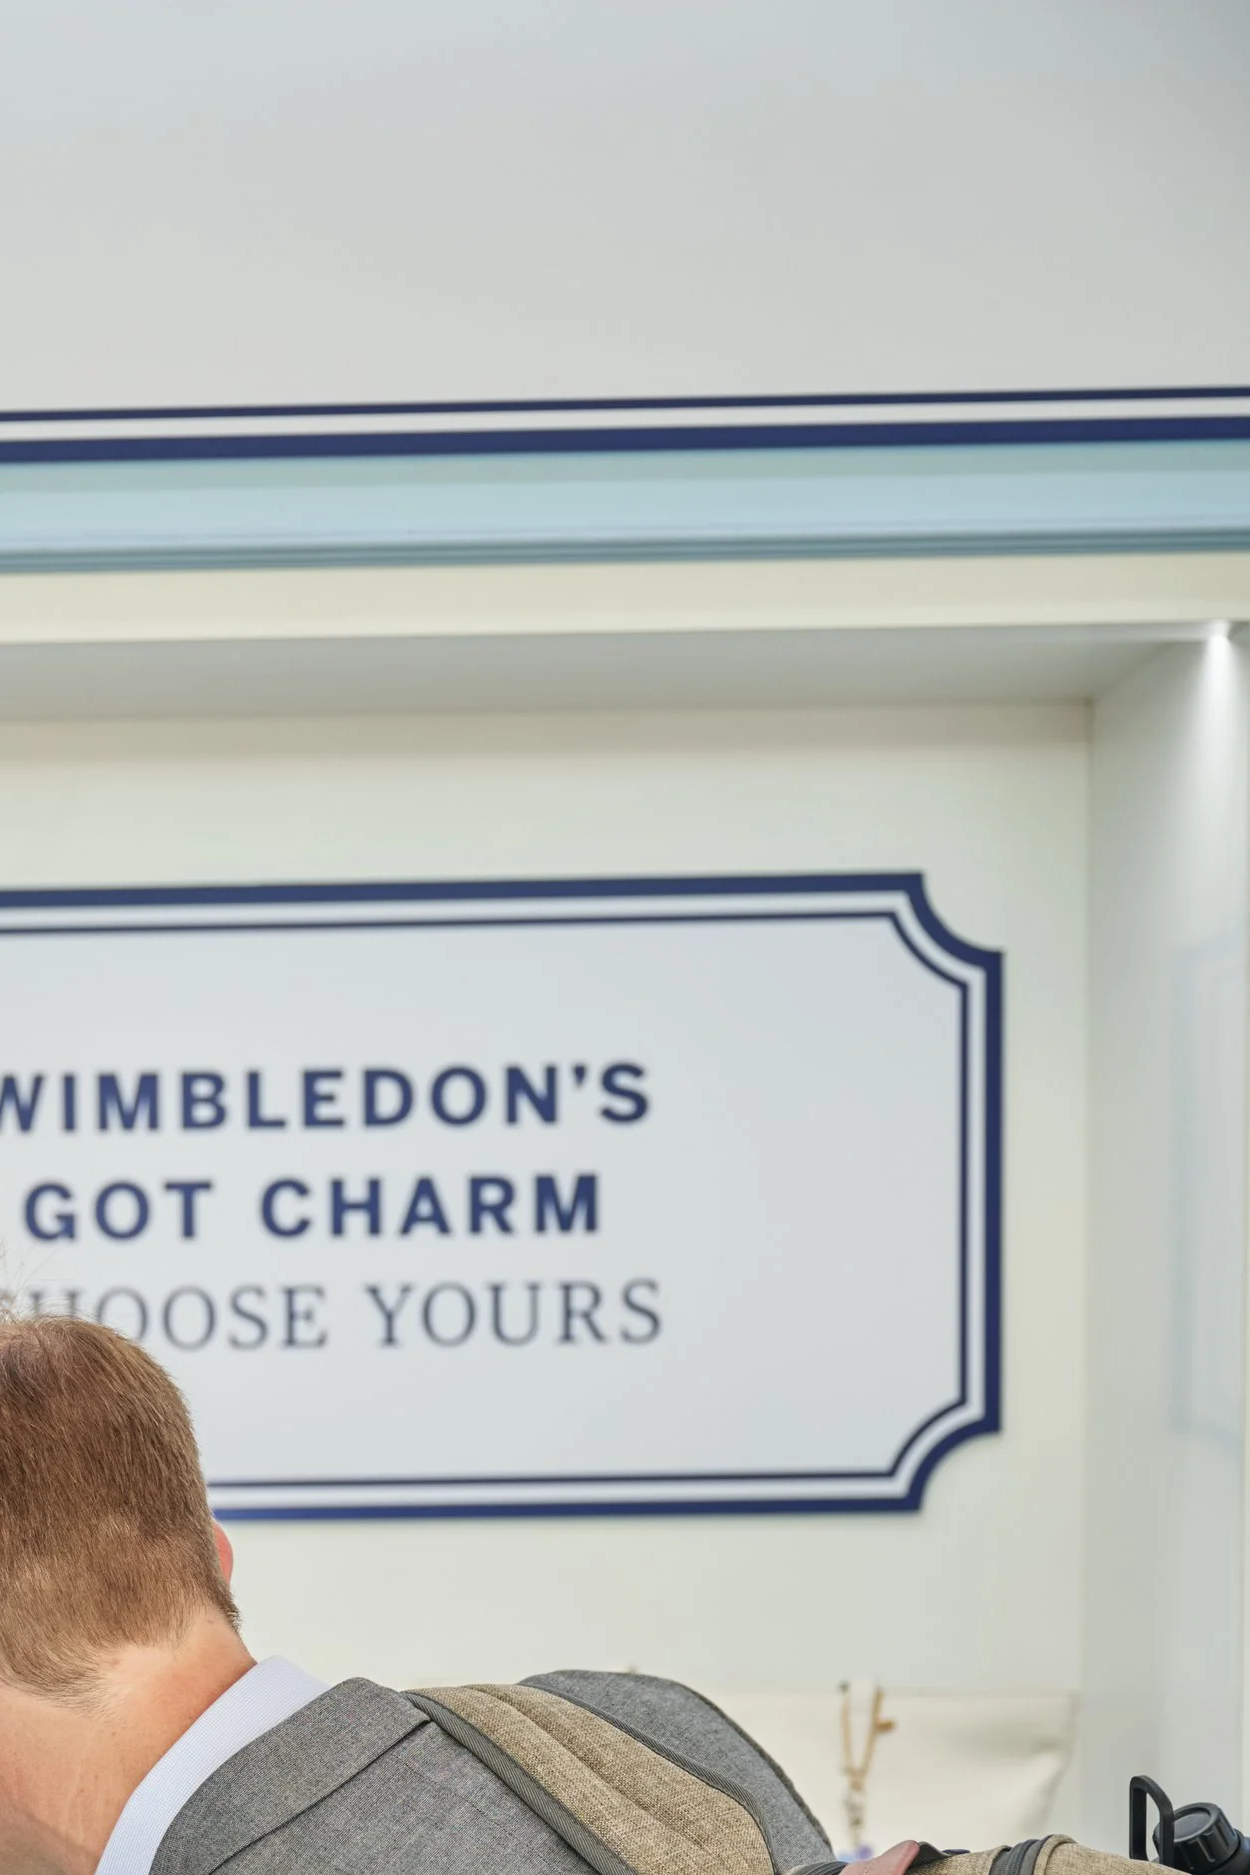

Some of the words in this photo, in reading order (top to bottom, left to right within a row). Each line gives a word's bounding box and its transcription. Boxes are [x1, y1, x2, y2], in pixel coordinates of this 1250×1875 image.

[23, 1179, 213, 1241] GOT
[259, 1173, 601, 1238] CHARM
[362, 1278, 663, 1347] YOURS
